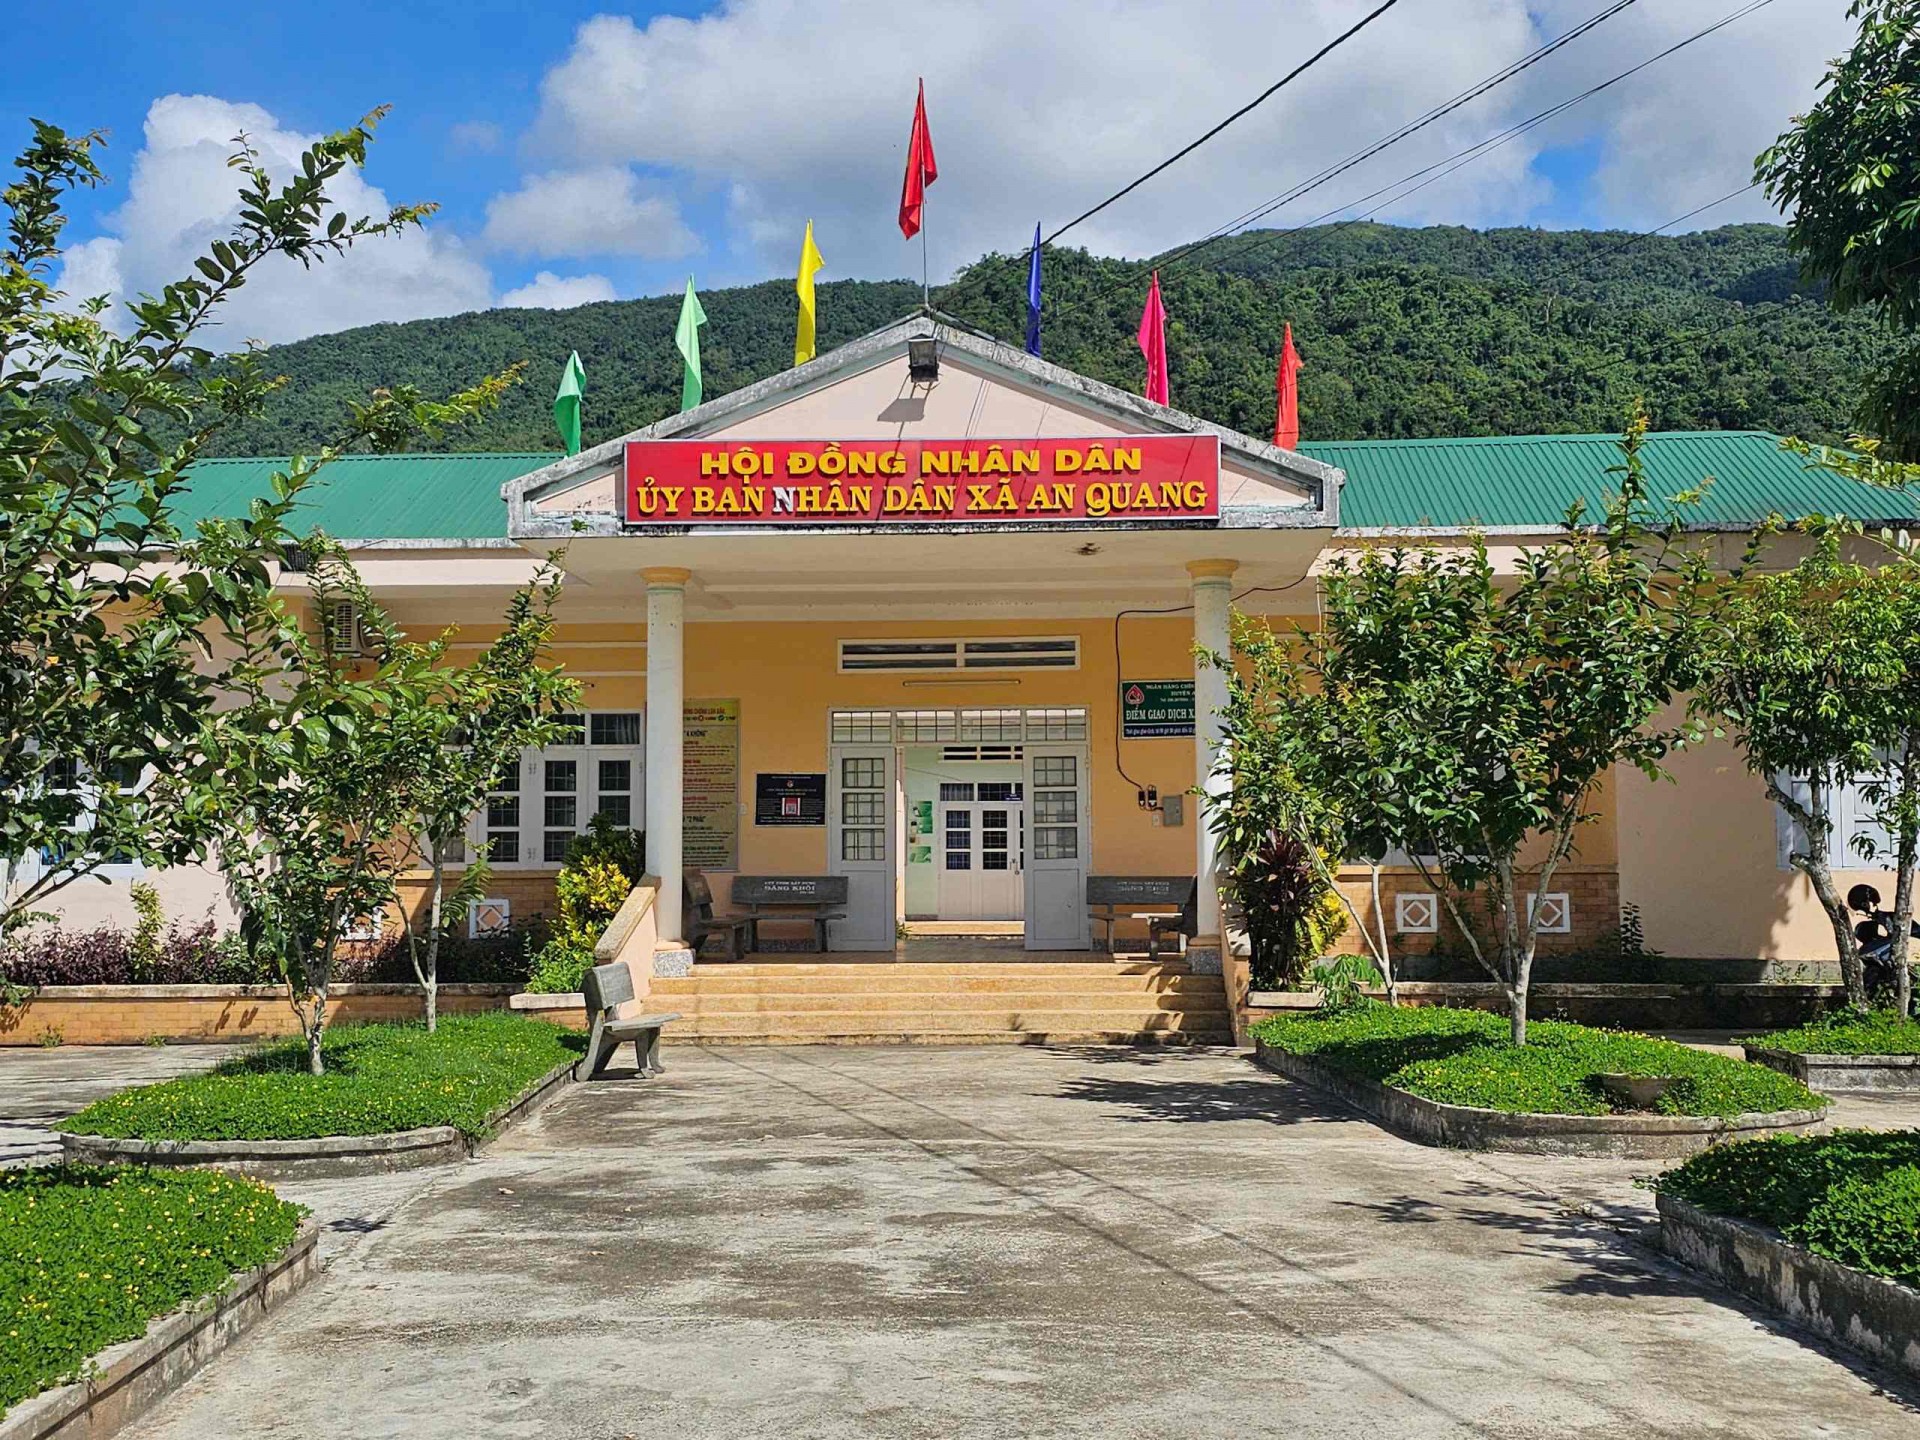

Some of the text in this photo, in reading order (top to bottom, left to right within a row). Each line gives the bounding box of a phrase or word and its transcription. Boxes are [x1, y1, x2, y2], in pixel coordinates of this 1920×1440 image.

[701, 442, 1142, 484] HỘI ĐỒNG NHÂN DÂN
[637, 476, 1209, 517] ỦY BAN NHÂN DÂN XÃ AN QUANG
[1125, 705, 1147, 720] ĐIỂM
[1147, 708, 1166, 720] GIAO
[1167, 708, 1187, 721] DỊCH
